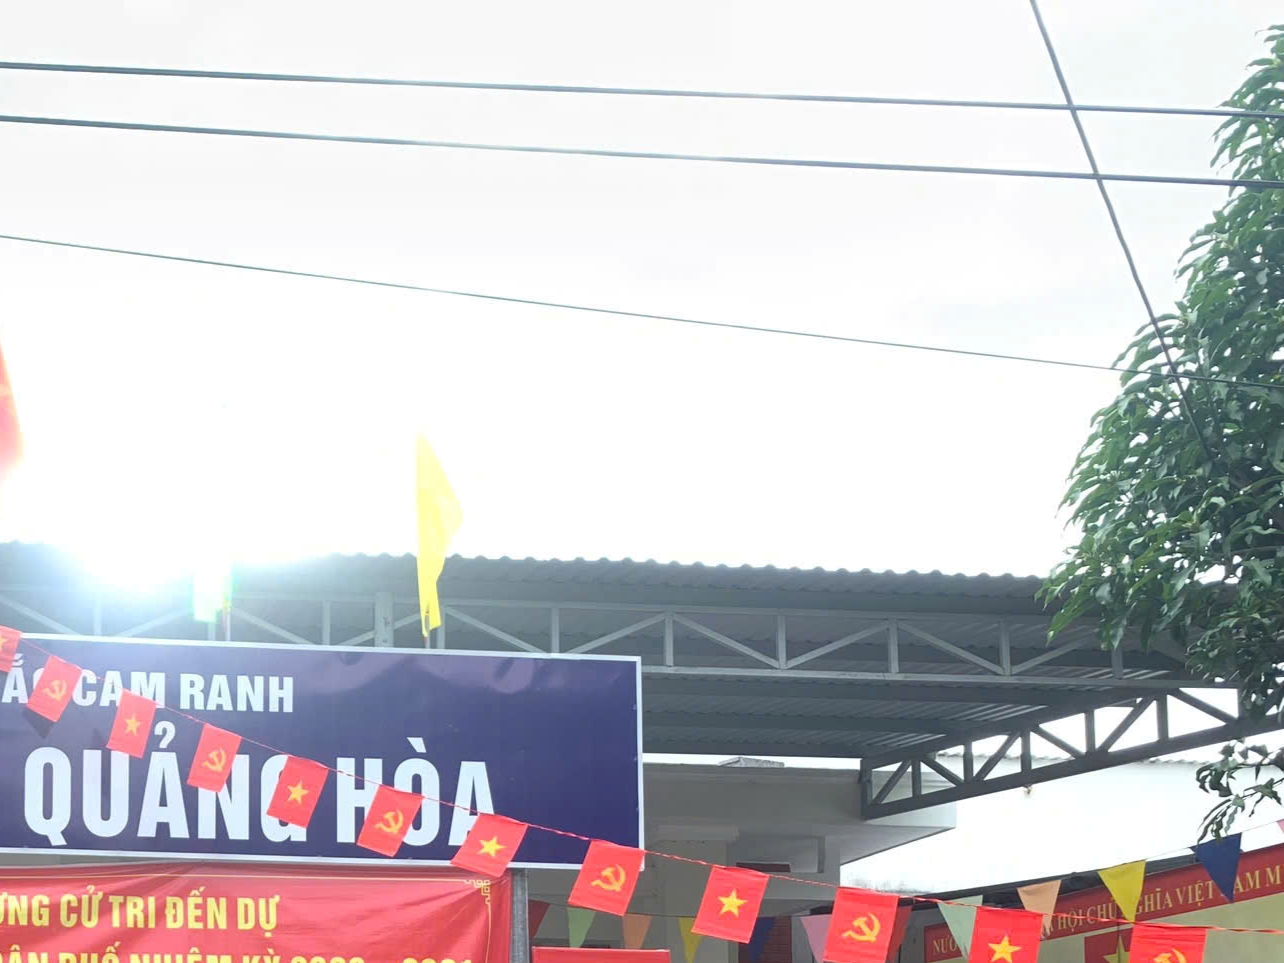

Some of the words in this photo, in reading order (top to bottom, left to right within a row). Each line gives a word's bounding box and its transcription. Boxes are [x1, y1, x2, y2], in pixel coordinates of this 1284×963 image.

[72, 668, 166, 709] CAM
[179, 673, 294, 713] RANH
[336, 736, 496, 847] HÒA
[59, 884, 104, 929] CỬ
[109, 895, 156, 929] TRI
[165, 886, 228, 930] ĐẾN
[237, 894, 281, 938] DỰ
[1175, 879, 1215, 907] VIỆT
[1233, 869, 1261, 894] AM
